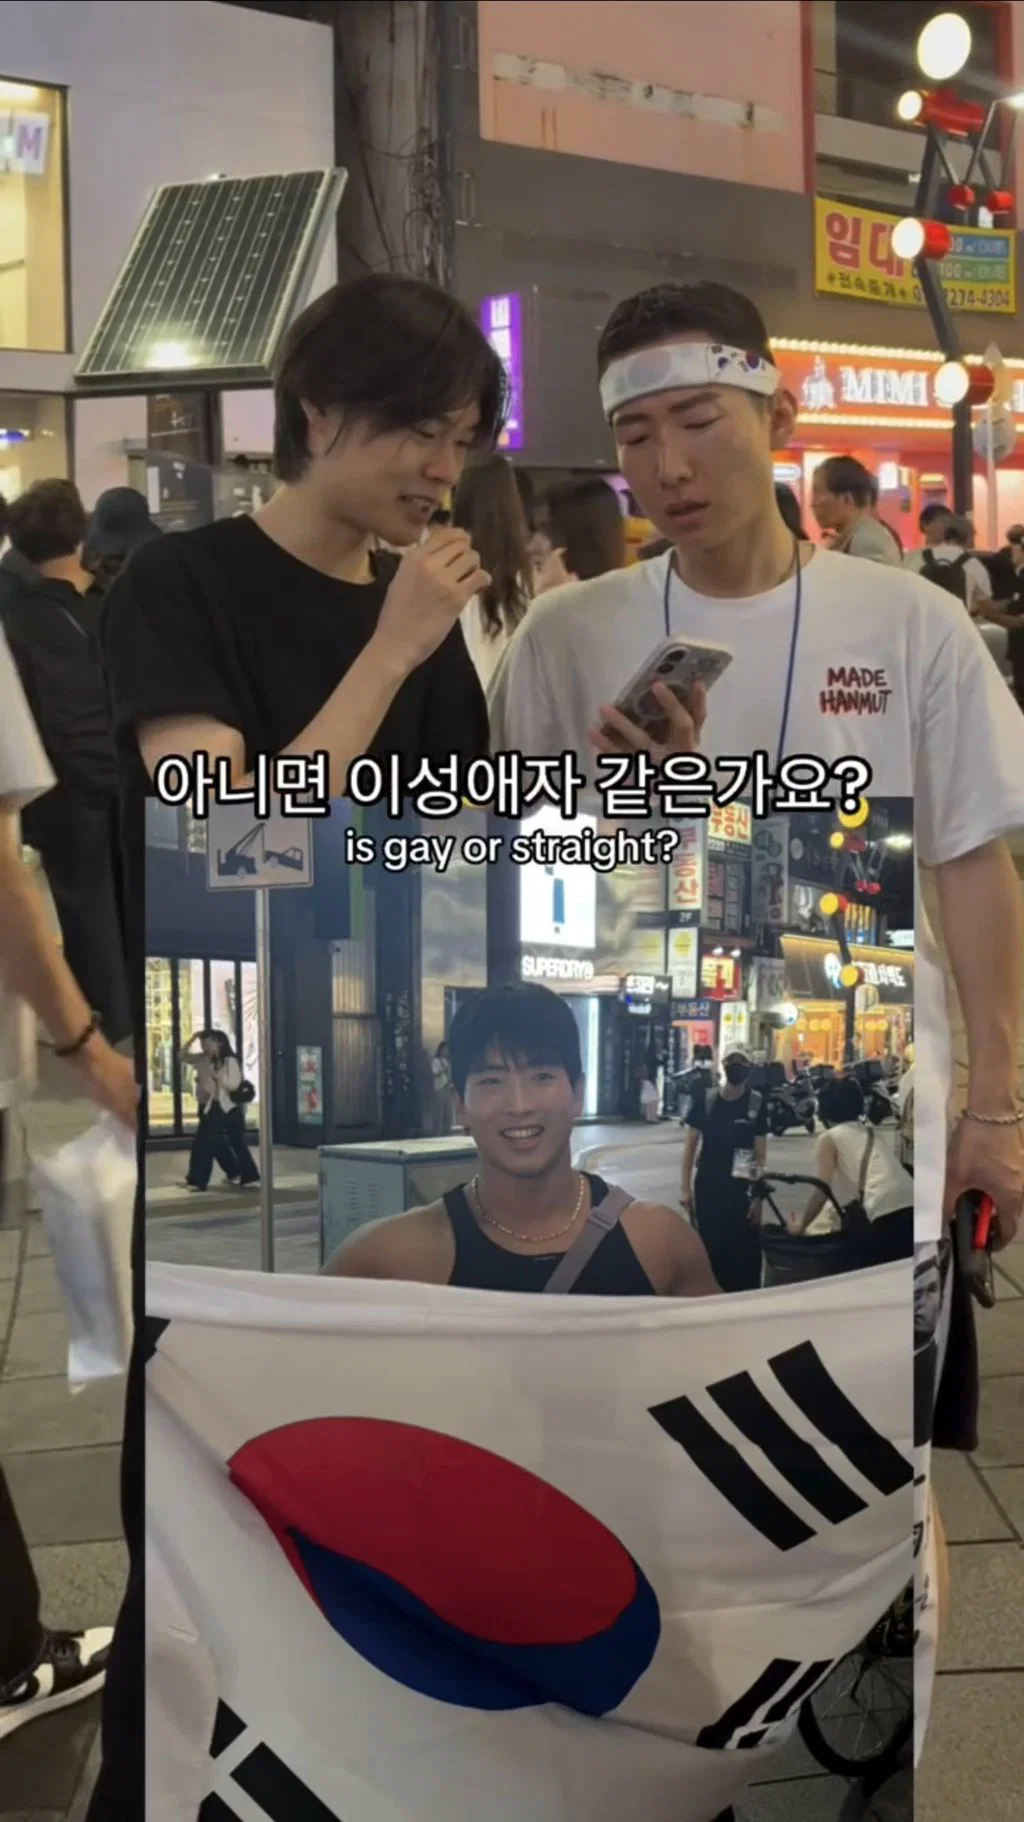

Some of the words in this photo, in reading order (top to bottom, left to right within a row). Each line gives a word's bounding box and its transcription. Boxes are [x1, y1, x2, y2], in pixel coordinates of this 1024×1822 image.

[840, 366, 929, 406] MIMI
[827, 666, 888, 688] MADE
[819, 689, 892, 716] HANMUT
